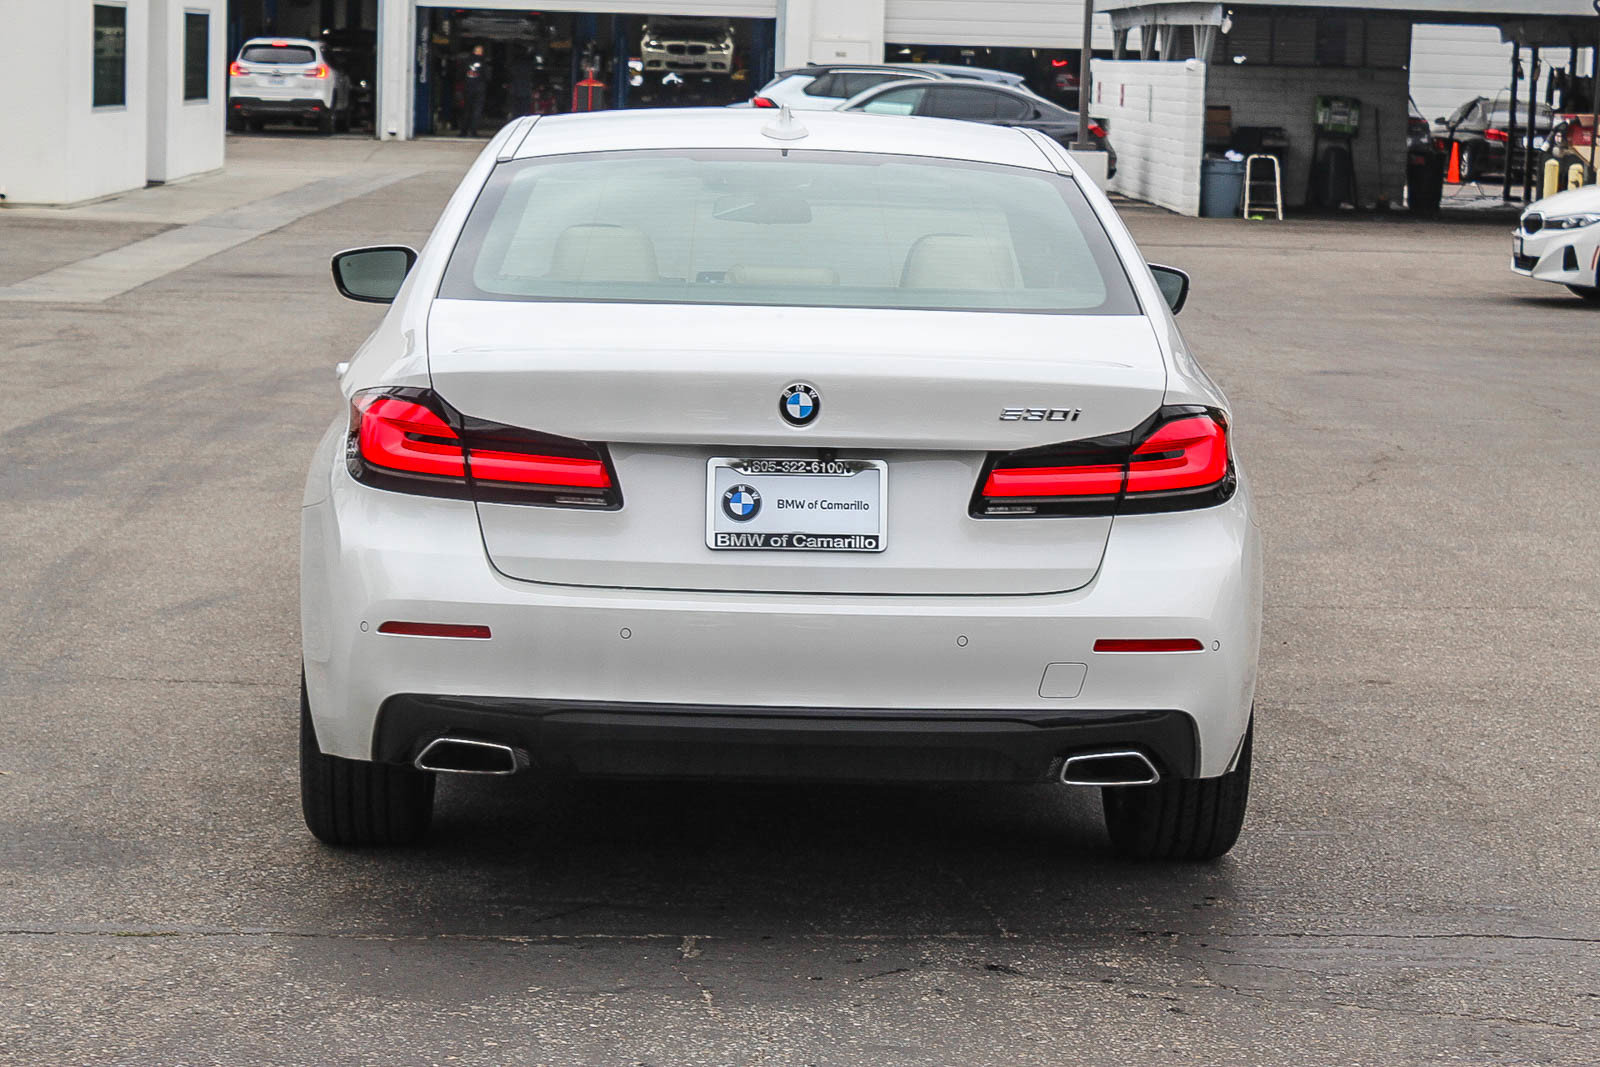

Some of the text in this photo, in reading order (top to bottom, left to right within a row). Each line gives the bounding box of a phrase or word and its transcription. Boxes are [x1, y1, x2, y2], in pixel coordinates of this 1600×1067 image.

[783, 384, 818, 399] BMW
[999, 407, 1082, 422] 530i
[752, 460, 845, 474] 805-322-6100
[725, 485, 761, 501] BMW
[777, 499, 870, 511] BMW of Camarillo
[717, 533, 877, 549] BMW of Camarillo
